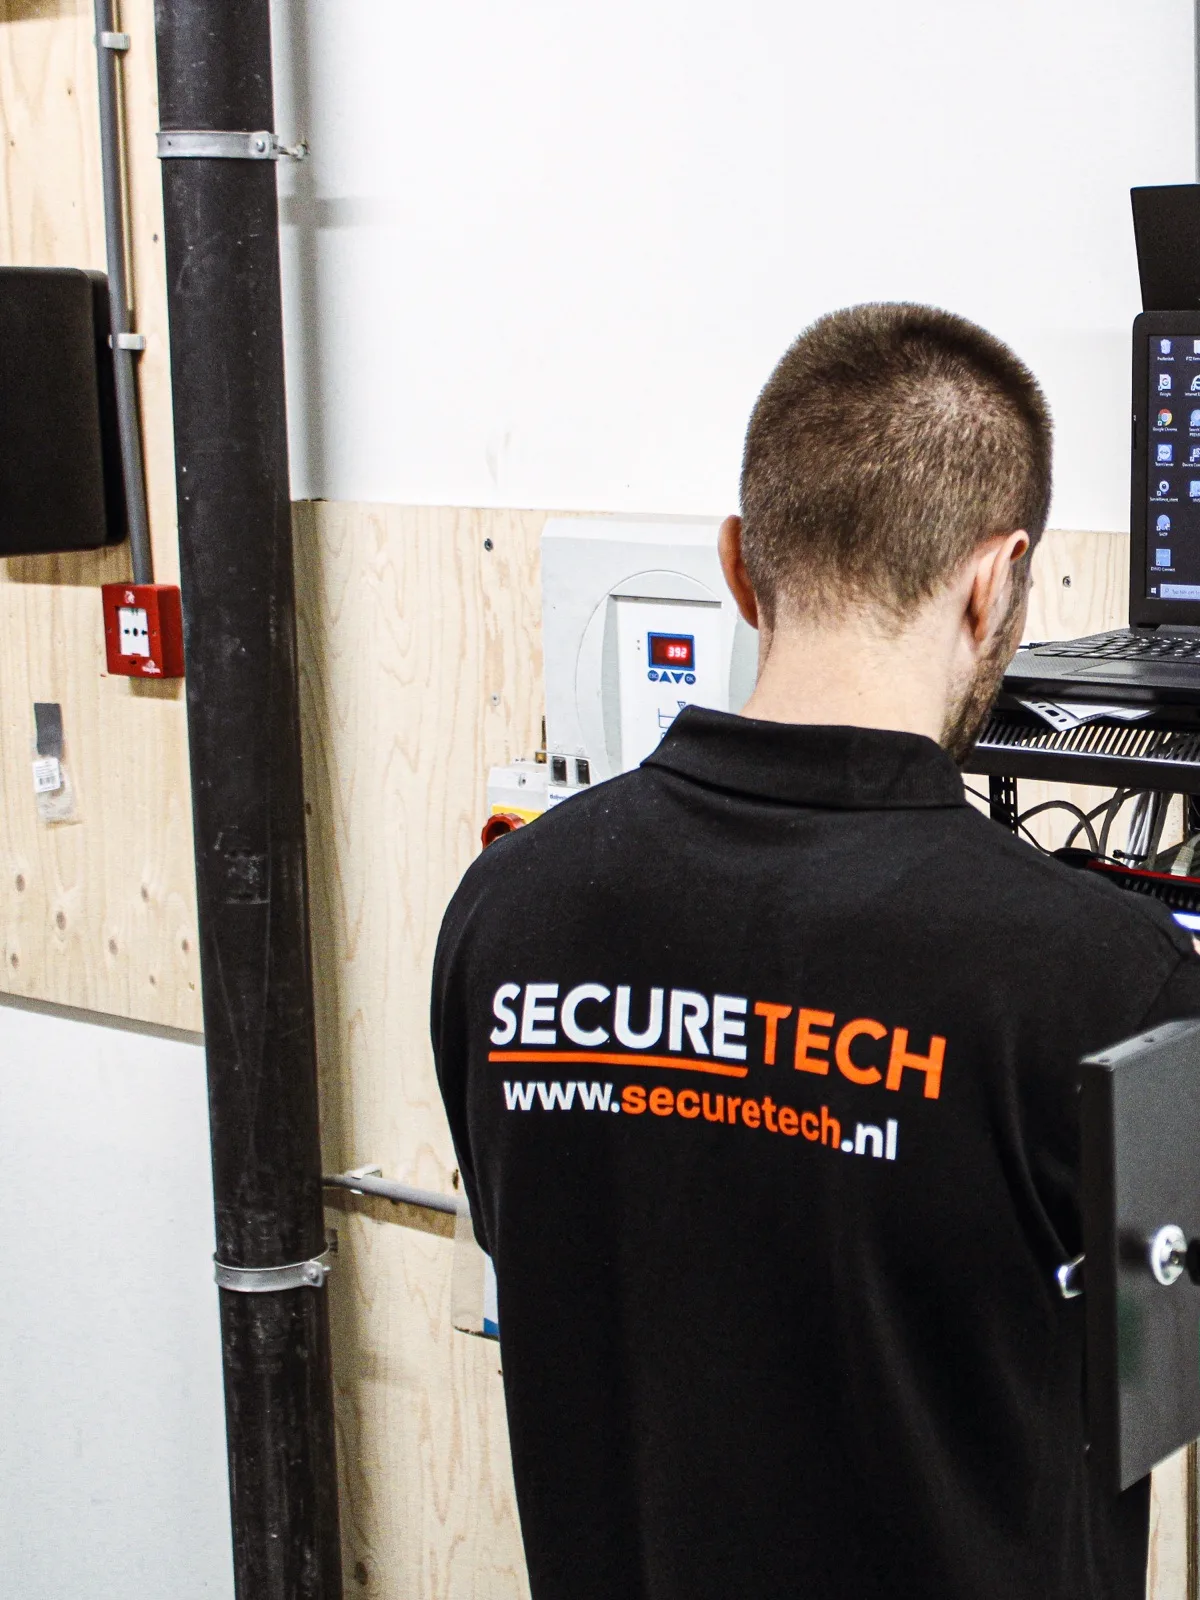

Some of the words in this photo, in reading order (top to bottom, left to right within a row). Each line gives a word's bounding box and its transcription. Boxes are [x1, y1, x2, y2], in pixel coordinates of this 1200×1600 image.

[667, 645, 688, 658] 392
[489, 982, 947, 1100] SECURETECH
[503, 1080, 899, 1161] www.securetech.nl
